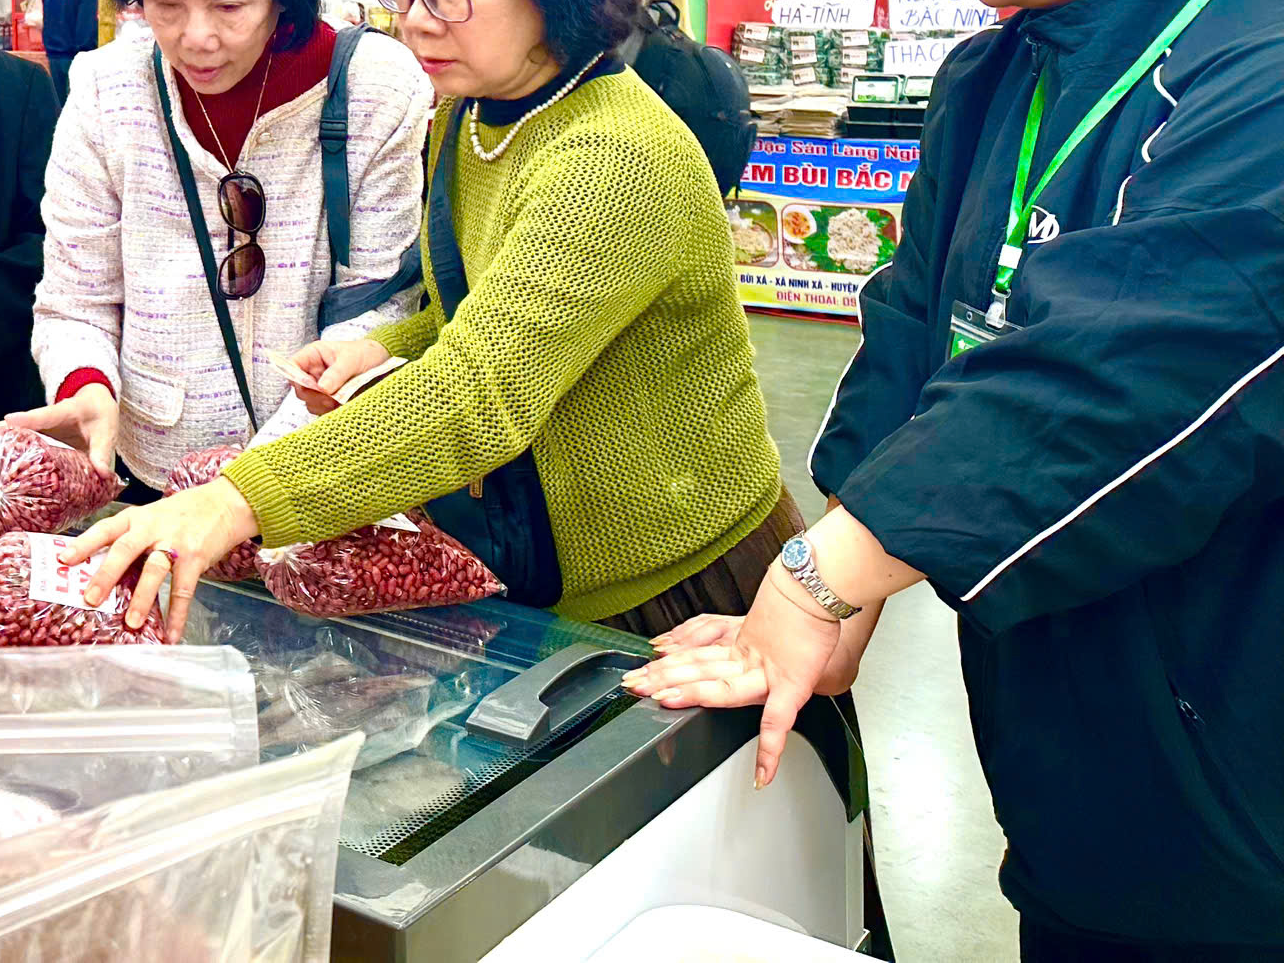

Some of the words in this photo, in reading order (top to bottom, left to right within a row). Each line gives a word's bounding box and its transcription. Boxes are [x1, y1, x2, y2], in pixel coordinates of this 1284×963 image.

[780, 3, 851, 24] HÀ-TĨNH
[953, 8, 998, 27] NINH
[791, 141, 827, 156] Sản
[833, 143, 879, 161] Làng
[885, 145, 921, 162] Ngh
[741, 164, 776, 184] EM
[783, 164, 828, 186] BÙI
[835, 163, 892, 190] BẮC
[788, 279, 809, 289] NINH
